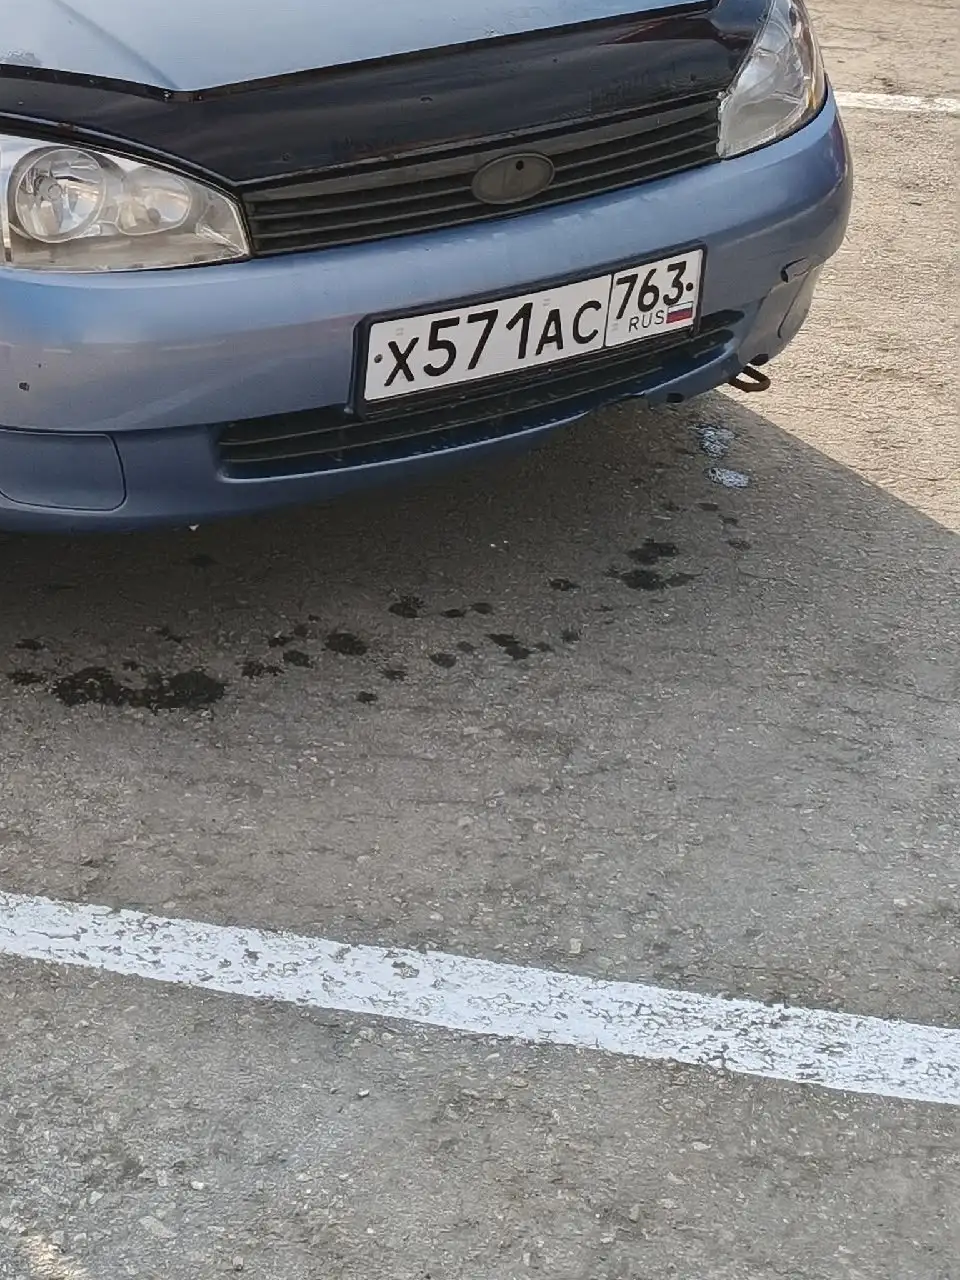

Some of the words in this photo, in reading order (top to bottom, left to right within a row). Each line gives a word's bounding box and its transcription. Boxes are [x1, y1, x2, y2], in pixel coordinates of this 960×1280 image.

[383, 300, 602, 386] Х571АС
[616, 261, 687, 319] 763
[628, 310, 665, 333] RUS
